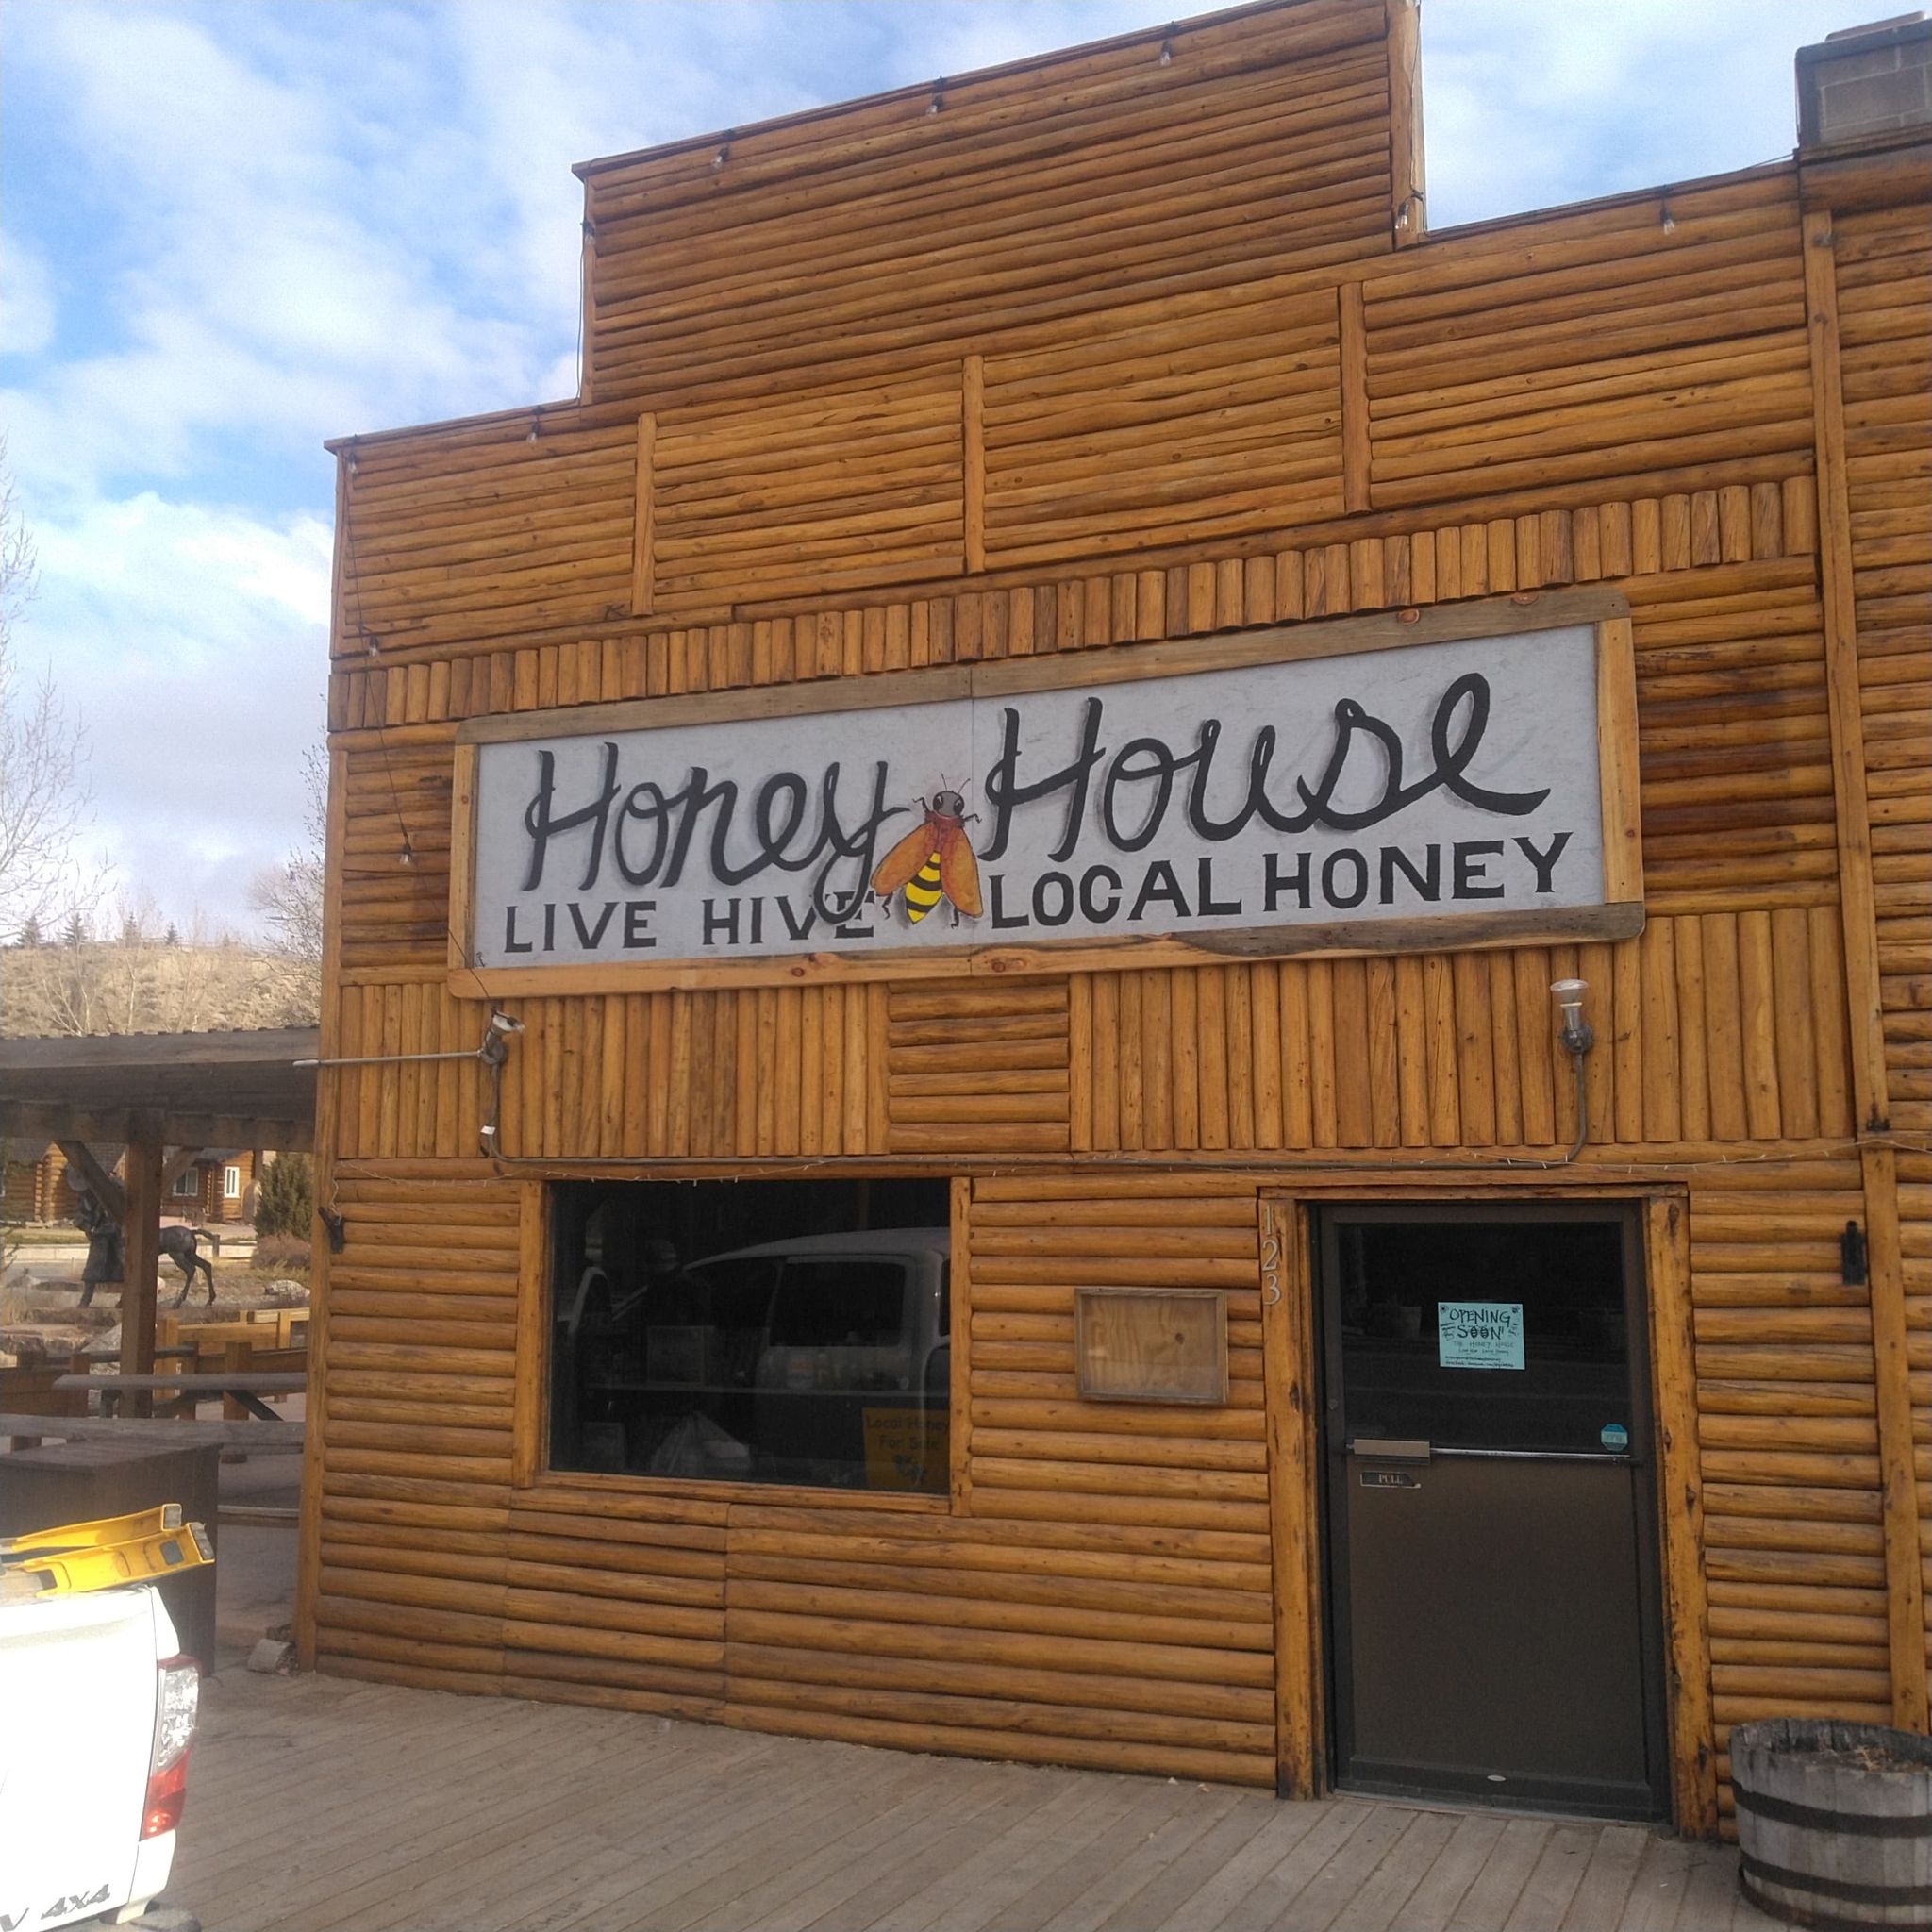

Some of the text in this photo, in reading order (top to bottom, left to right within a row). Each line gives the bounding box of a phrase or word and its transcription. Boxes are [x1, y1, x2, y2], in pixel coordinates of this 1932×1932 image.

[522, 672, 1551, 925] Honey House
[504, 831, 1573, 954] LIVE HIVE LOCAL HONEY
[1262, 1204, 1281, 1306] 123
[1449, 1307, 1511, 1328] OPENING
[1378, 1474, 1403, 1484] PULL
